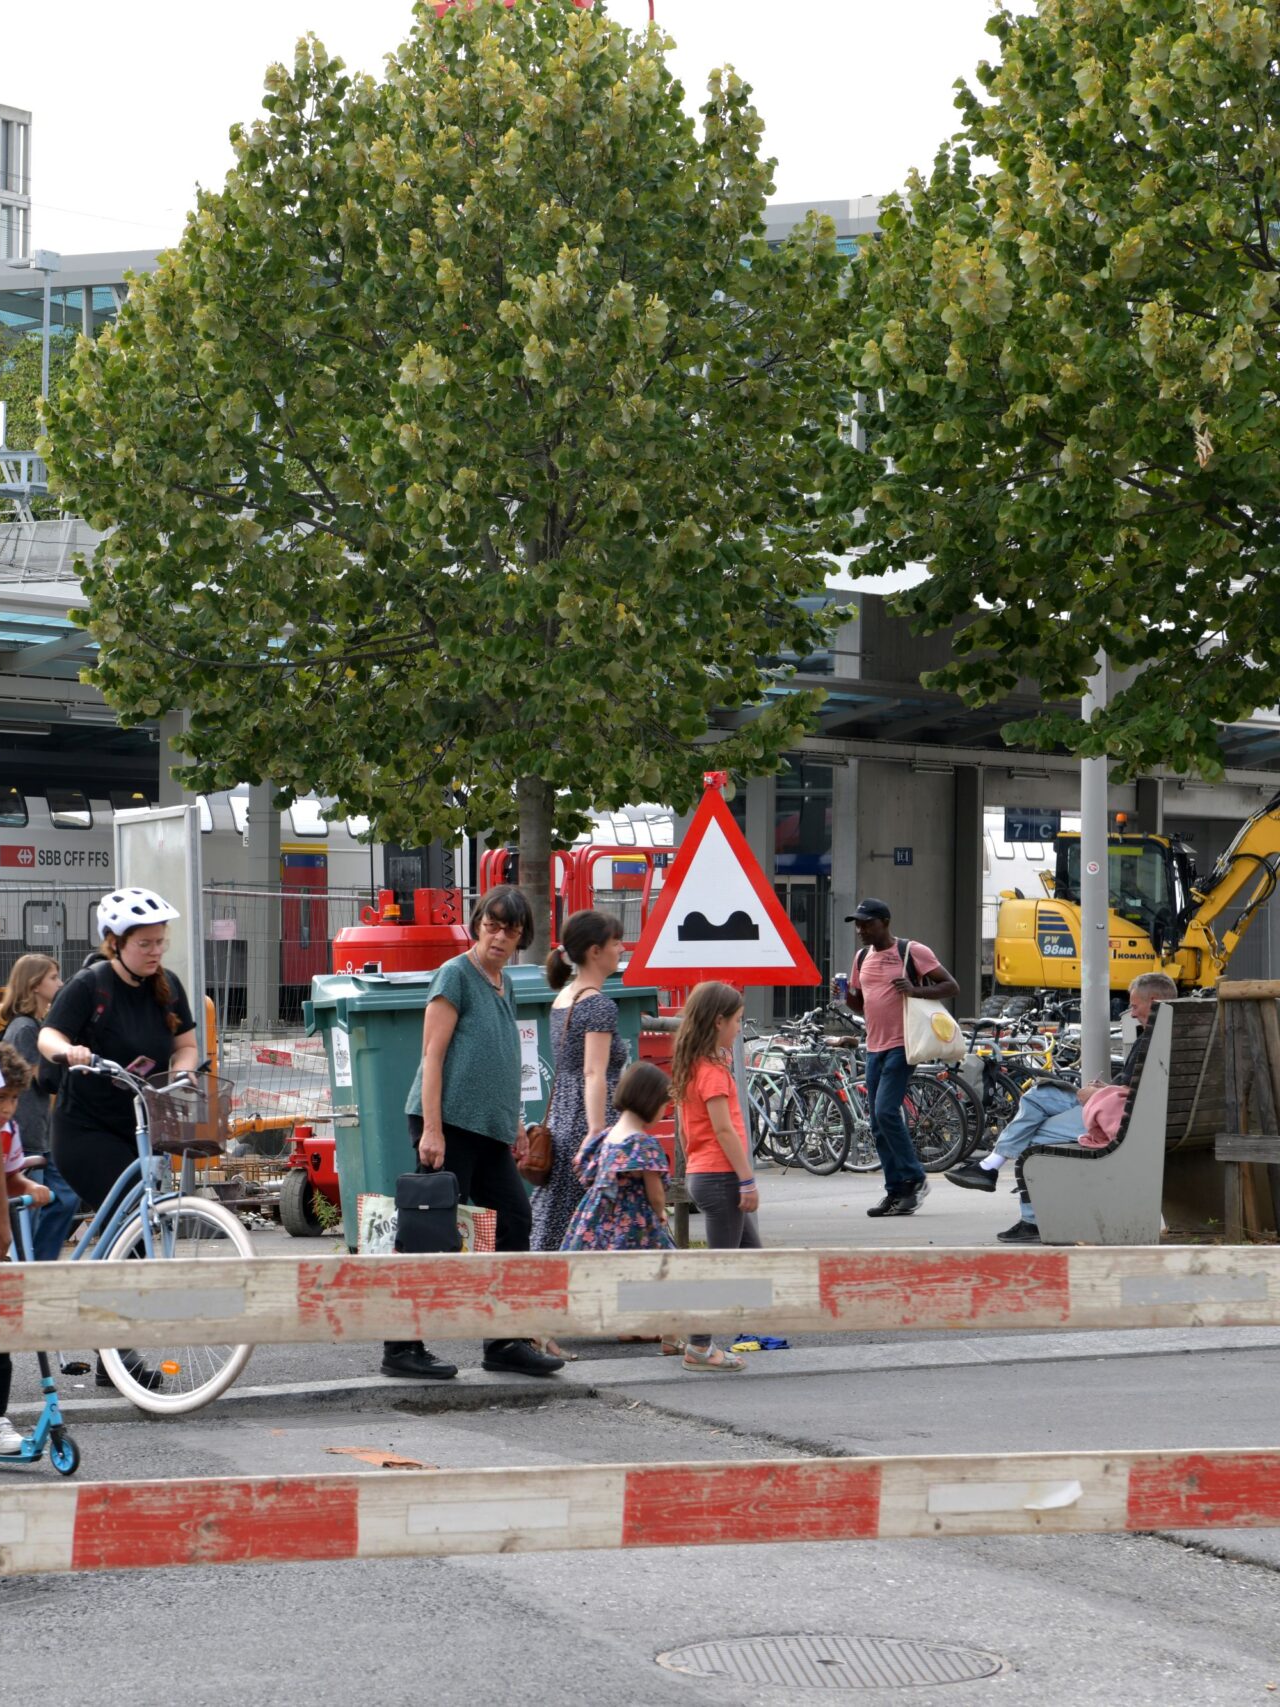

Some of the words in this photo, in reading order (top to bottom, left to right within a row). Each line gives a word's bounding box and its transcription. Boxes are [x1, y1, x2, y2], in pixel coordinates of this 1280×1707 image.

[1013, 823, 1023, 838] 7
[1039, 824, 1053, 839] C
[38, 850, 61, 866] SBB
[63, 851, 85, 867] CFF
[88, 852, 110, 868] FFS
[614, 862, 618, 873] 1
[1043, 935, 1061, 944] PW
[1043, 944, 1074, 955] 98MR
[1117, 952, 1156, 960] KOMATSU
